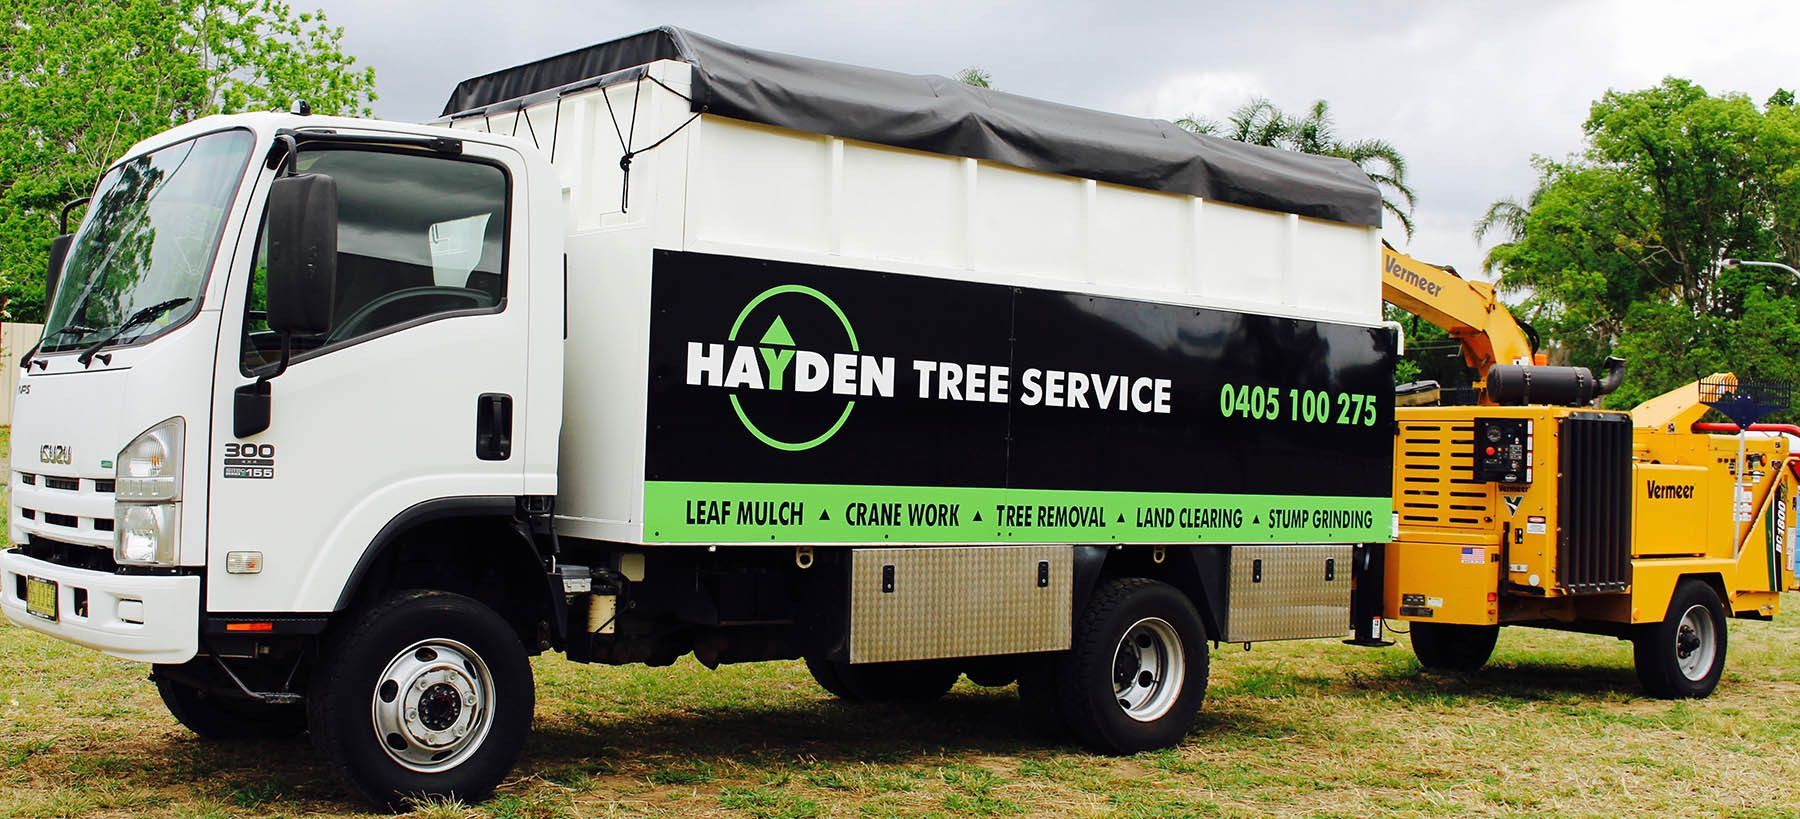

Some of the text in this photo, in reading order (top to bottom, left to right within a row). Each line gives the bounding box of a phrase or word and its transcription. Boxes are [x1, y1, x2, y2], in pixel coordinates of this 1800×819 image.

[1385, 254, 1442, 297] Vermeer
[686, 341, 1172, 414] HAYDEN TREE SERVICE
[1220, 383, 1377, 427] 0405 100 275
[40, 444, 72, 465] ISUZU
[224, 443, 275, 458] 300
[246, 468, 273, 477] 155
[1647, 480, 1695, 499] Vermeer
[686, 500, 1373, 529] LEAF MULCH CRANE WORK TREE REMOVAL LAND CLEARING STUMP GRINDING
[1775, 500, 1786, 554] BC1800
